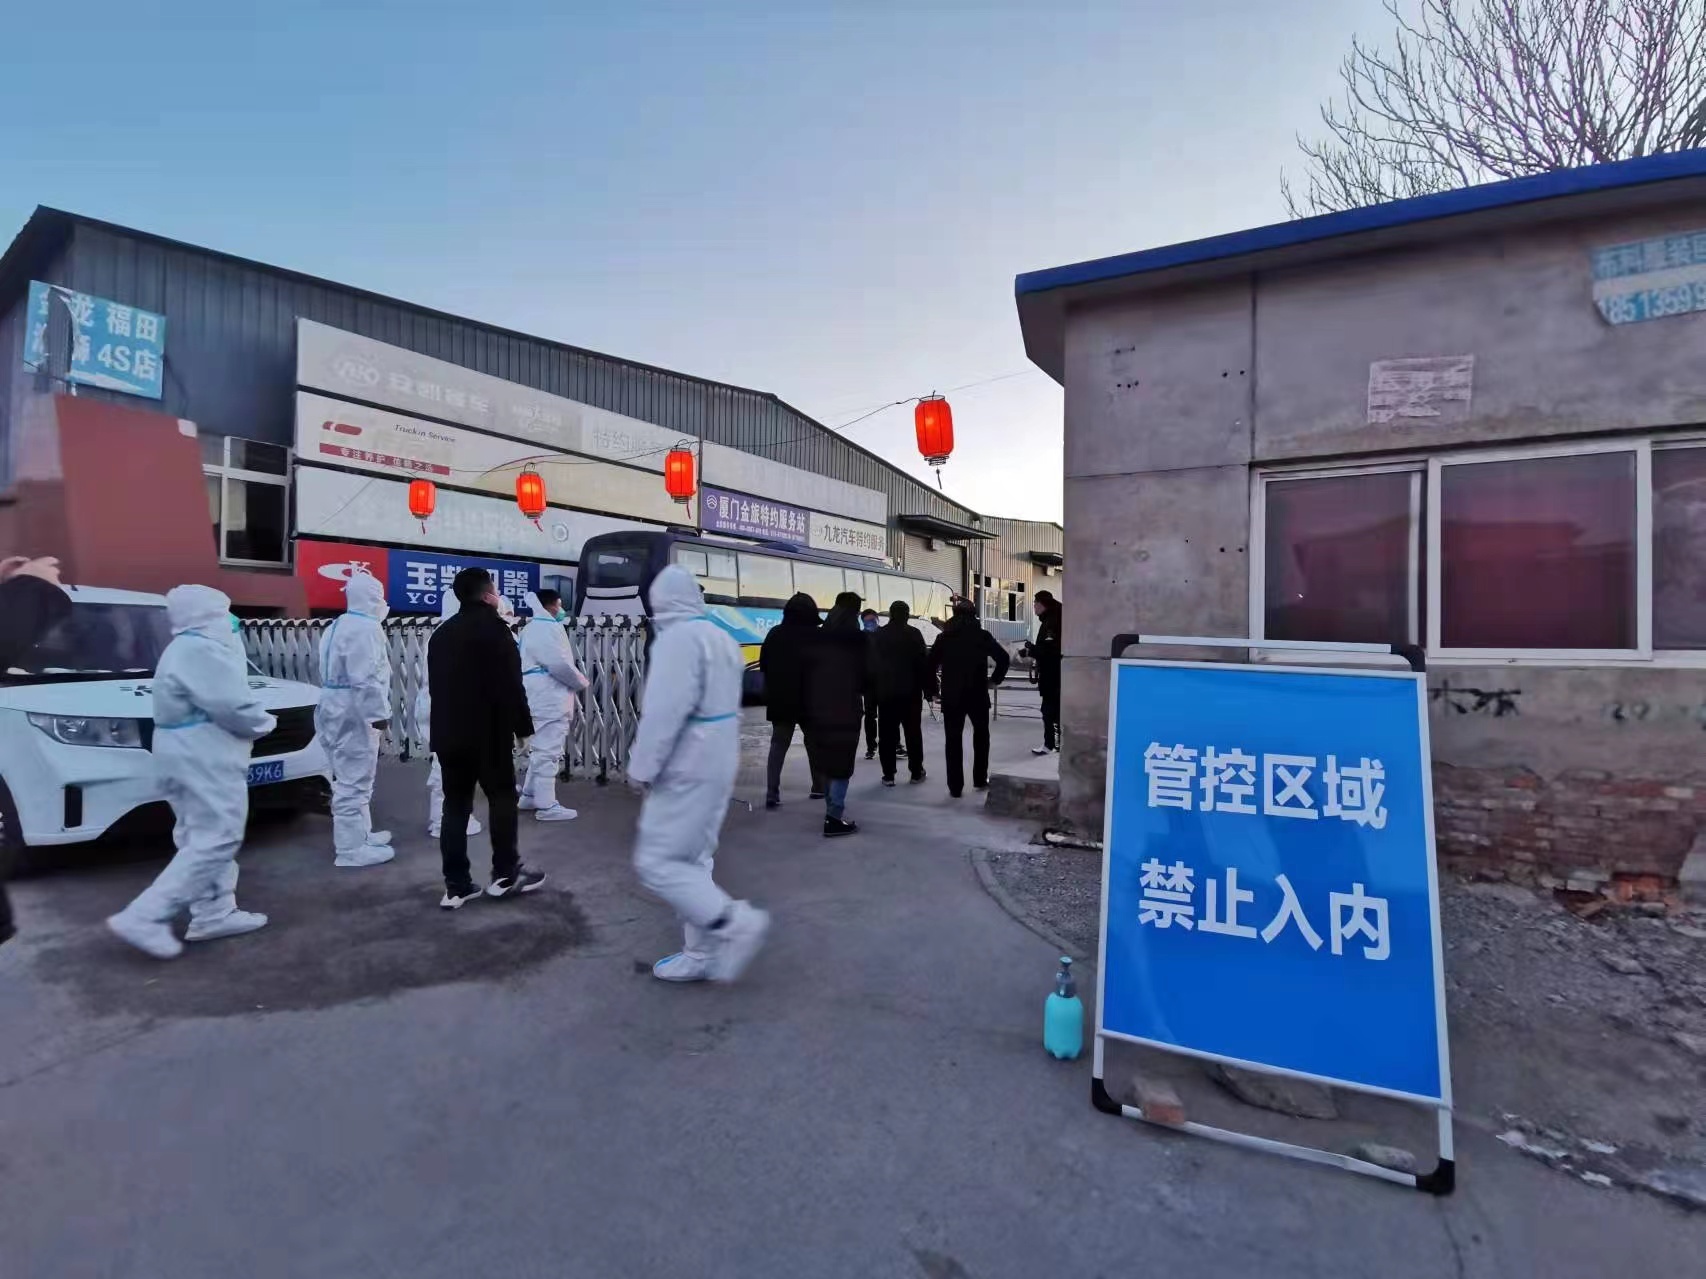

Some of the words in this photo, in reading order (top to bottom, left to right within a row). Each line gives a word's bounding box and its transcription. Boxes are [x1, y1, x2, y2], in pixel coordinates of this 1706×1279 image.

[107, 301, 158, 342] 福田
[97, 343, 158, 380] 4S店
[719, 496, 805, 533] 厦门金旅特约服务站
[823, 524, 885, 552] 九龙汽车特约服务
[406, 561, 529, 597] 玉柴器
[1144, 742, 1388, 830] 管控区域
[1138, 858, 1390, 960] 禁止入内
